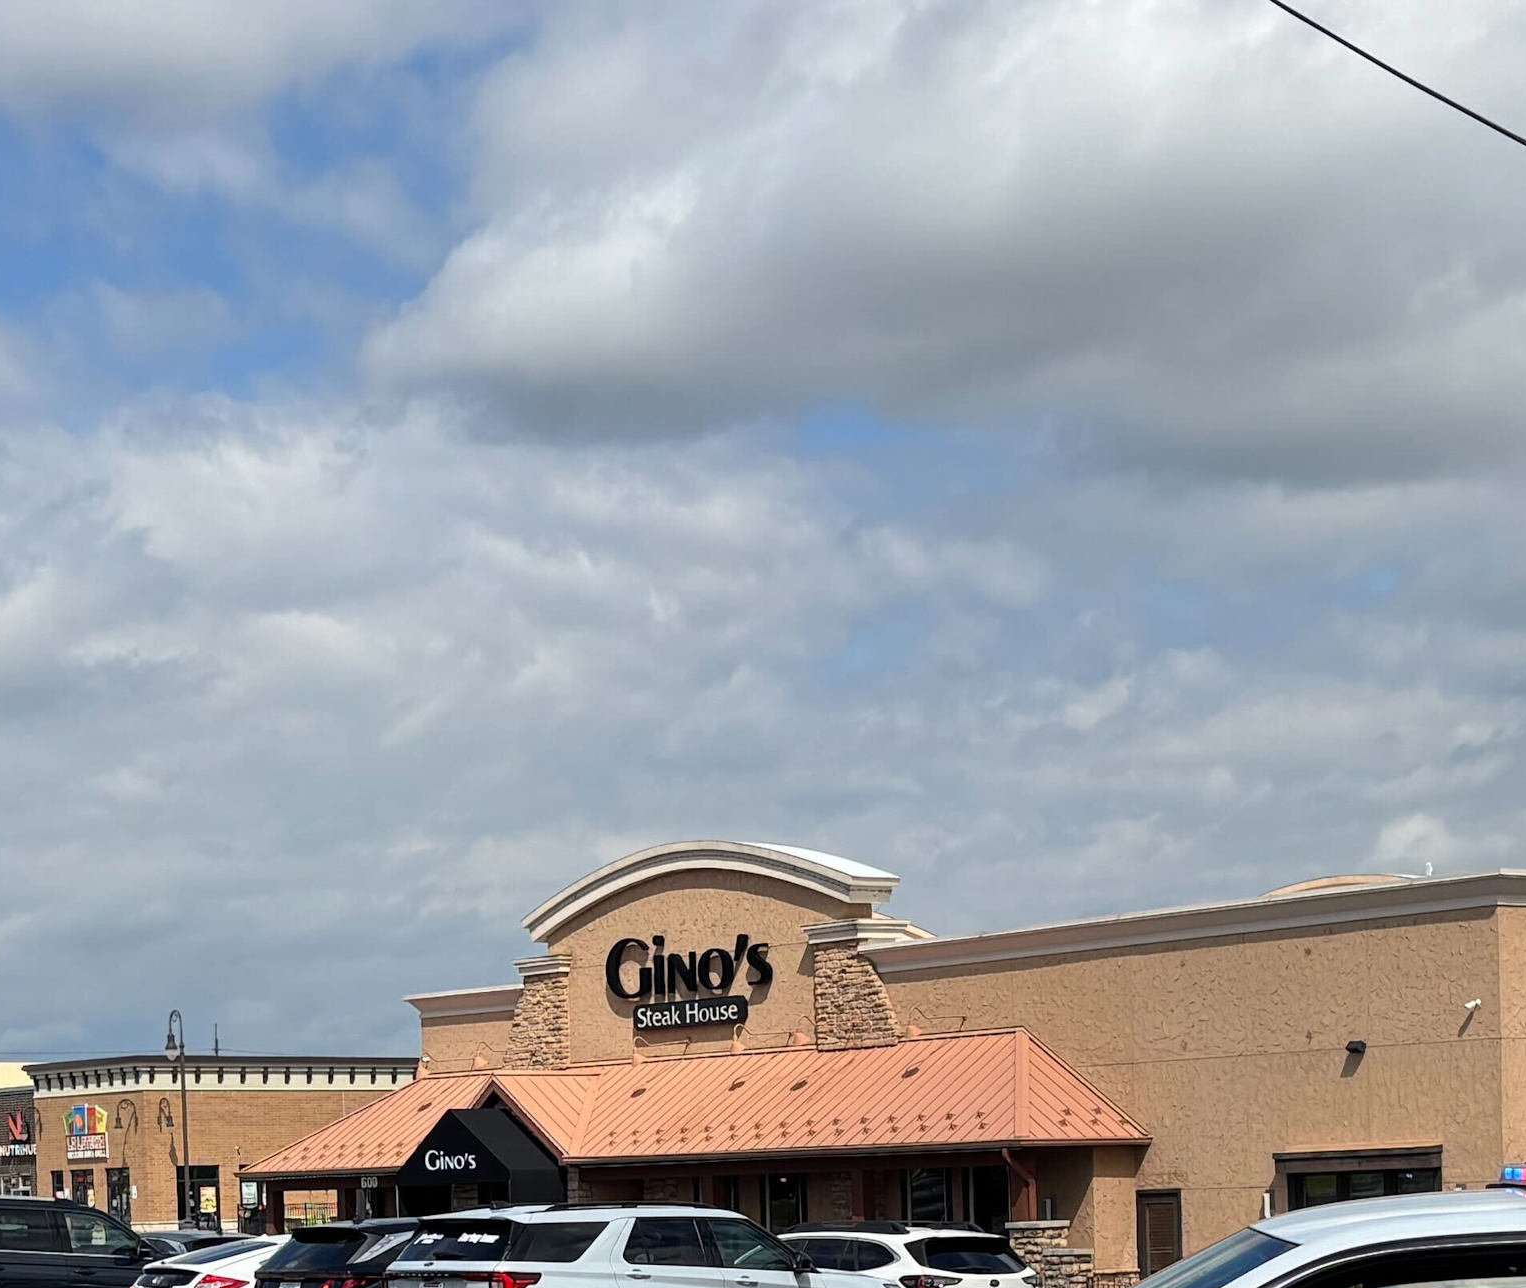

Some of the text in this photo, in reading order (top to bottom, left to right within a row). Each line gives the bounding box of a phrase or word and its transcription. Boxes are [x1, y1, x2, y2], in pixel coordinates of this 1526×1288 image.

[637, 1002, 739, 1029] Steak House
[360, 1176, 378, 1189] 600
